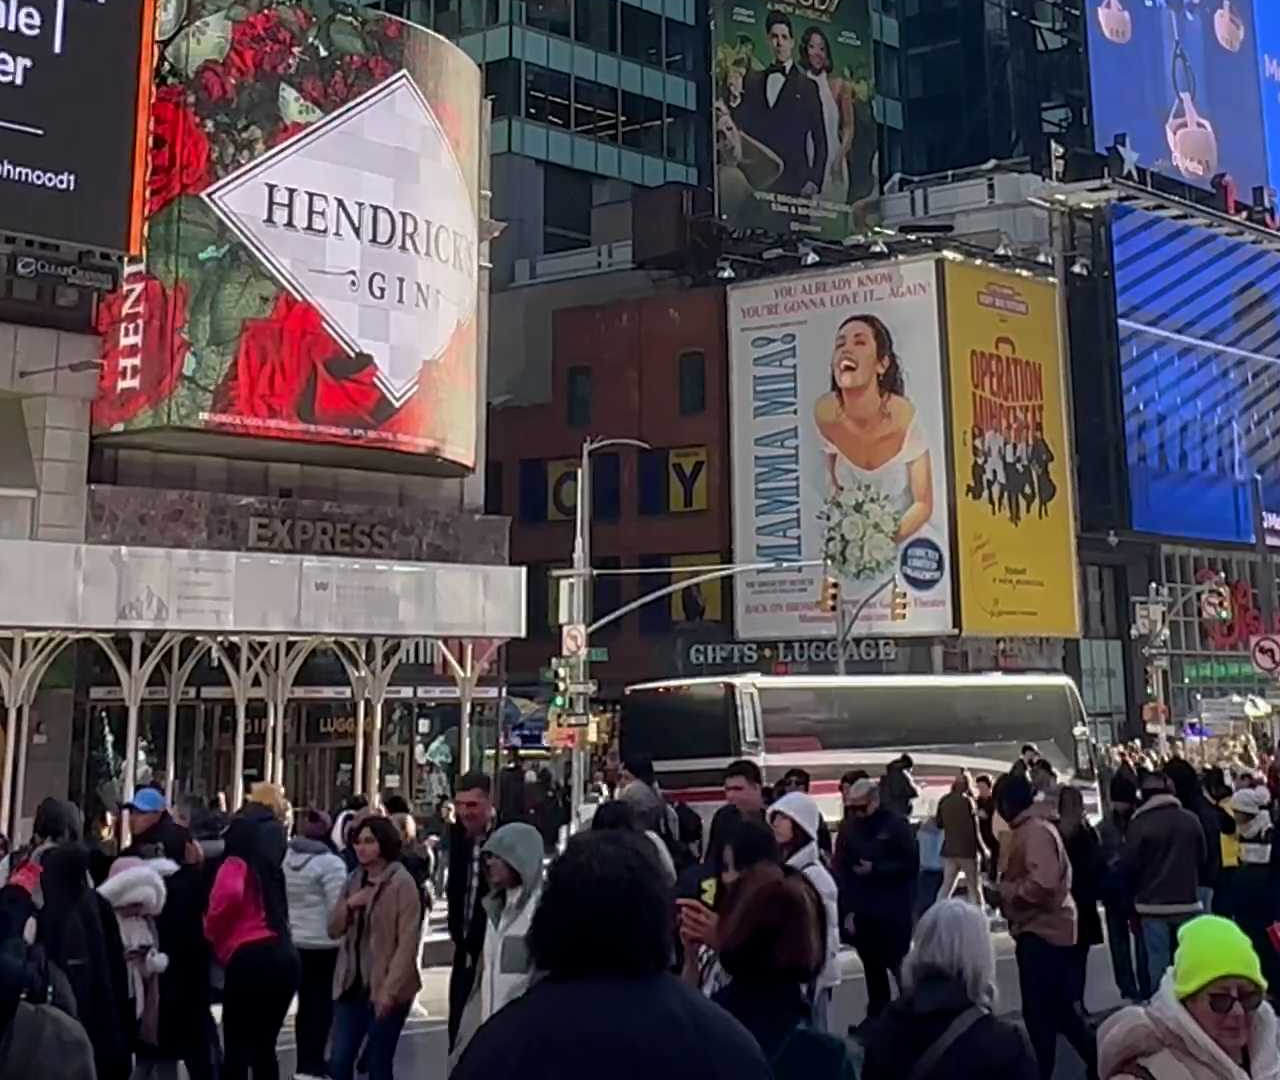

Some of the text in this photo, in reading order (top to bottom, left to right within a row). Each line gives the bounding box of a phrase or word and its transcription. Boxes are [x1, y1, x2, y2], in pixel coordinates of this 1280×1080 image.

[367, 271, 431, 310] GIN
[773, 272, 894, 300] YOU ALREADY KNOW
[740, 301, 779, 320] YOU'RE
[783, 298, 826, 316] GONNA
[830, 291, 860, 308] LOVE
[750, 333, 798, 420] MIA!
[971, 349, 1043, 402] OPERATION
[754, 425, 803, 576] MAMMA
[248, 516, 390, 554] EXPRESS
[689, 639, 898, 665] GIFTS LUGGAGE
